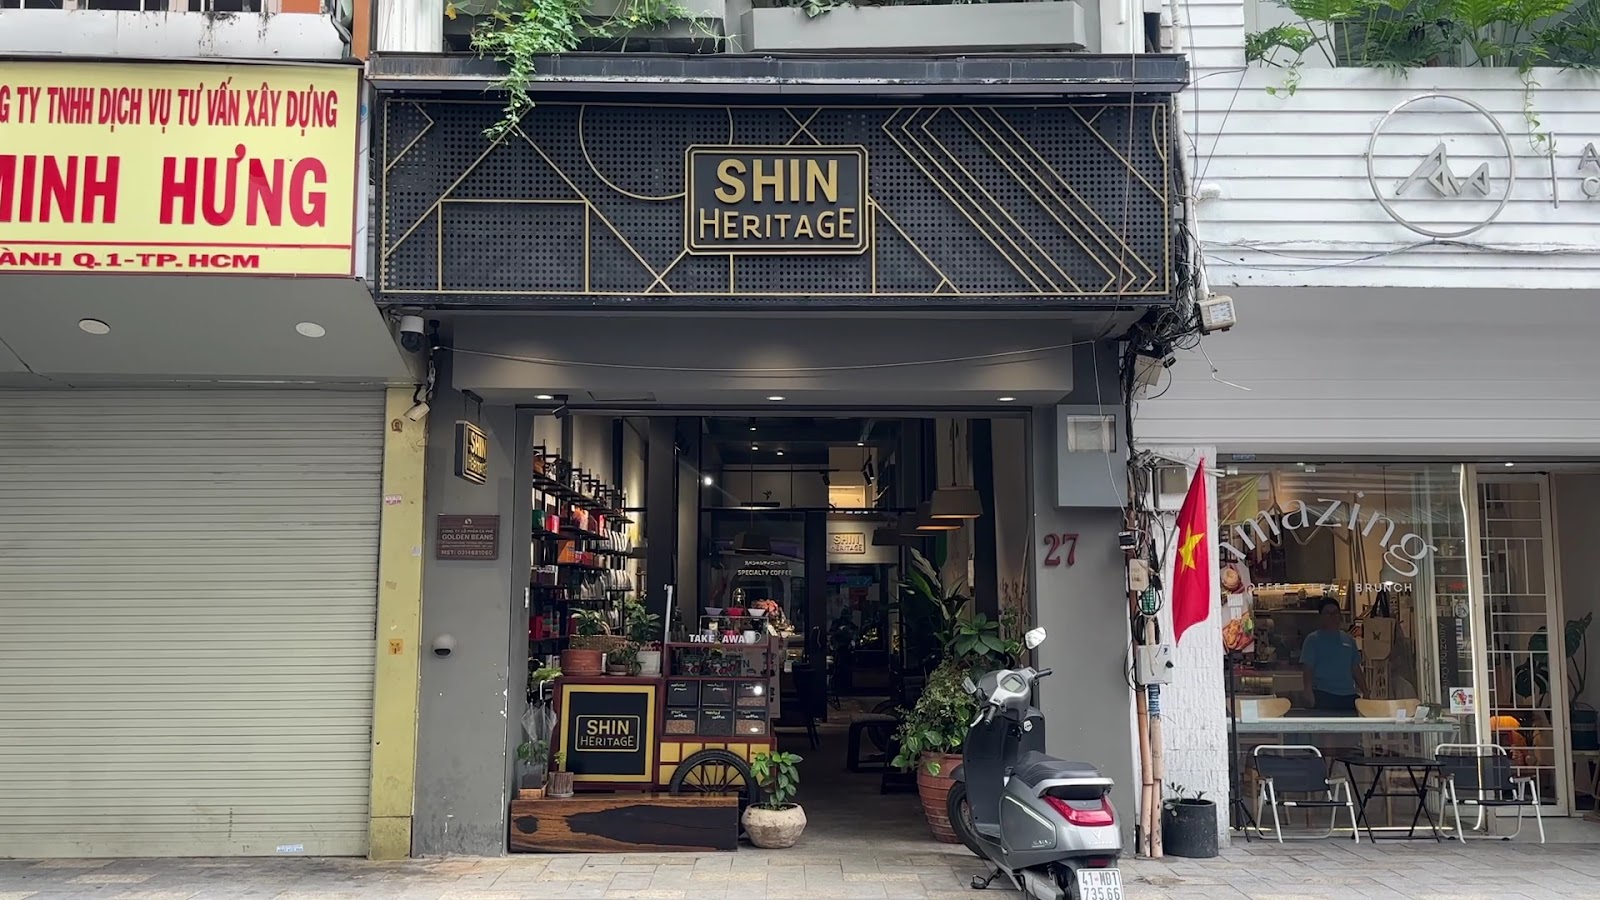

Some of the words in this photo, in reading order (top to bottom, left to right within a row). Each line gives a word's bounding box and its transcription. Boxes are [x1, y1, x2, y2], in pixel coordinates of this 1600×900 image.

[17, 87, 41, 123] TY
[47, 87, 94, 124] TNHH
[98, 87, 142, 133] DỊCH
[148, 88, 171, 134] VỤ
[178, 82, 203, 127] TƯ
[207, 76, 240, 126] VẤN
[244, 82, 281, 127] XÂY
[286, 83, 338, 137] DỰNG
[160, 144, 327, 227] HƯNG
[714, 159, 837, 203] SHIN
[699, 208, 855, 239] HERITAGE
[470, 431, 487, 460] SHIN
[1044, 533, 1079, 566] 27
[1355, 582, 1412, 593] BRUNCH
[689, 634, 715, 643] TAKE
[722, 634, 751, 644] AWA
[581, 736, 634, 746] HERITAGE
[587, 720, 629, 735] SHIN
